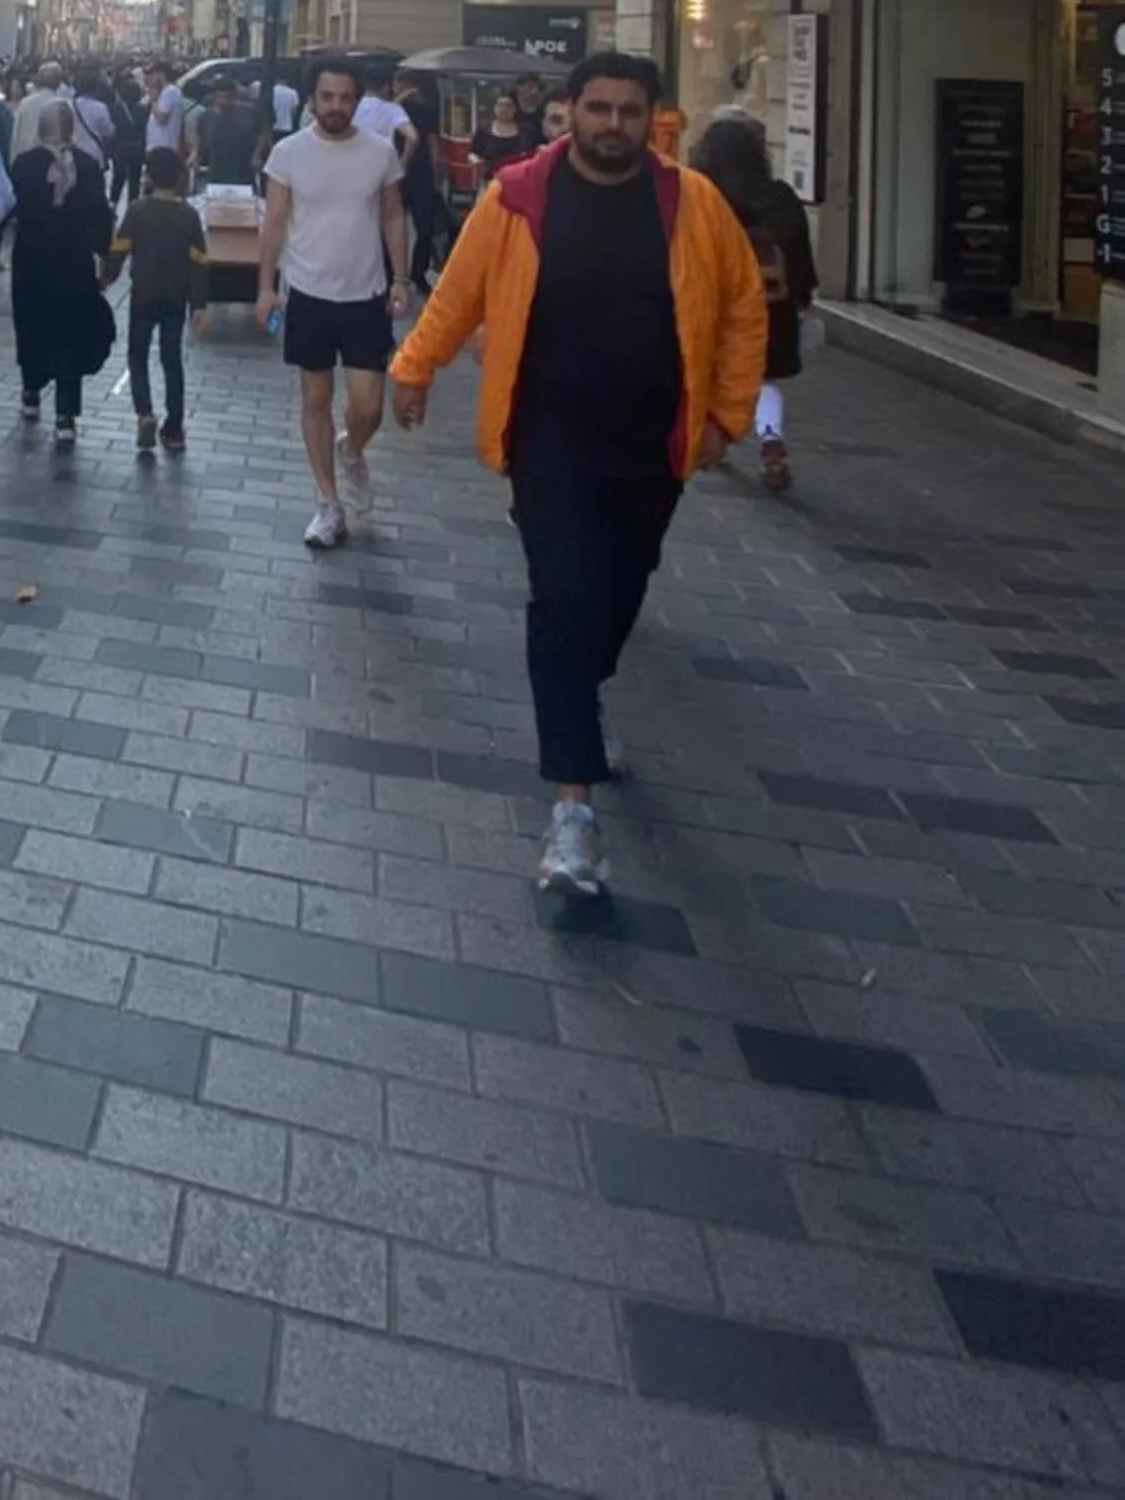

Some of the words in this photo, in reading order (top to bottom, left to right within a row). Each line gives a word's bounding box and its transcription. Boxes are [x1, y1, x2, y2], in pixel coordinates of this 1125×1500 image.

[1101, 67, 1113, 88] 5
[1099, 97, 1113, 116] 4
[1100, 155, 1112, 176] 2
